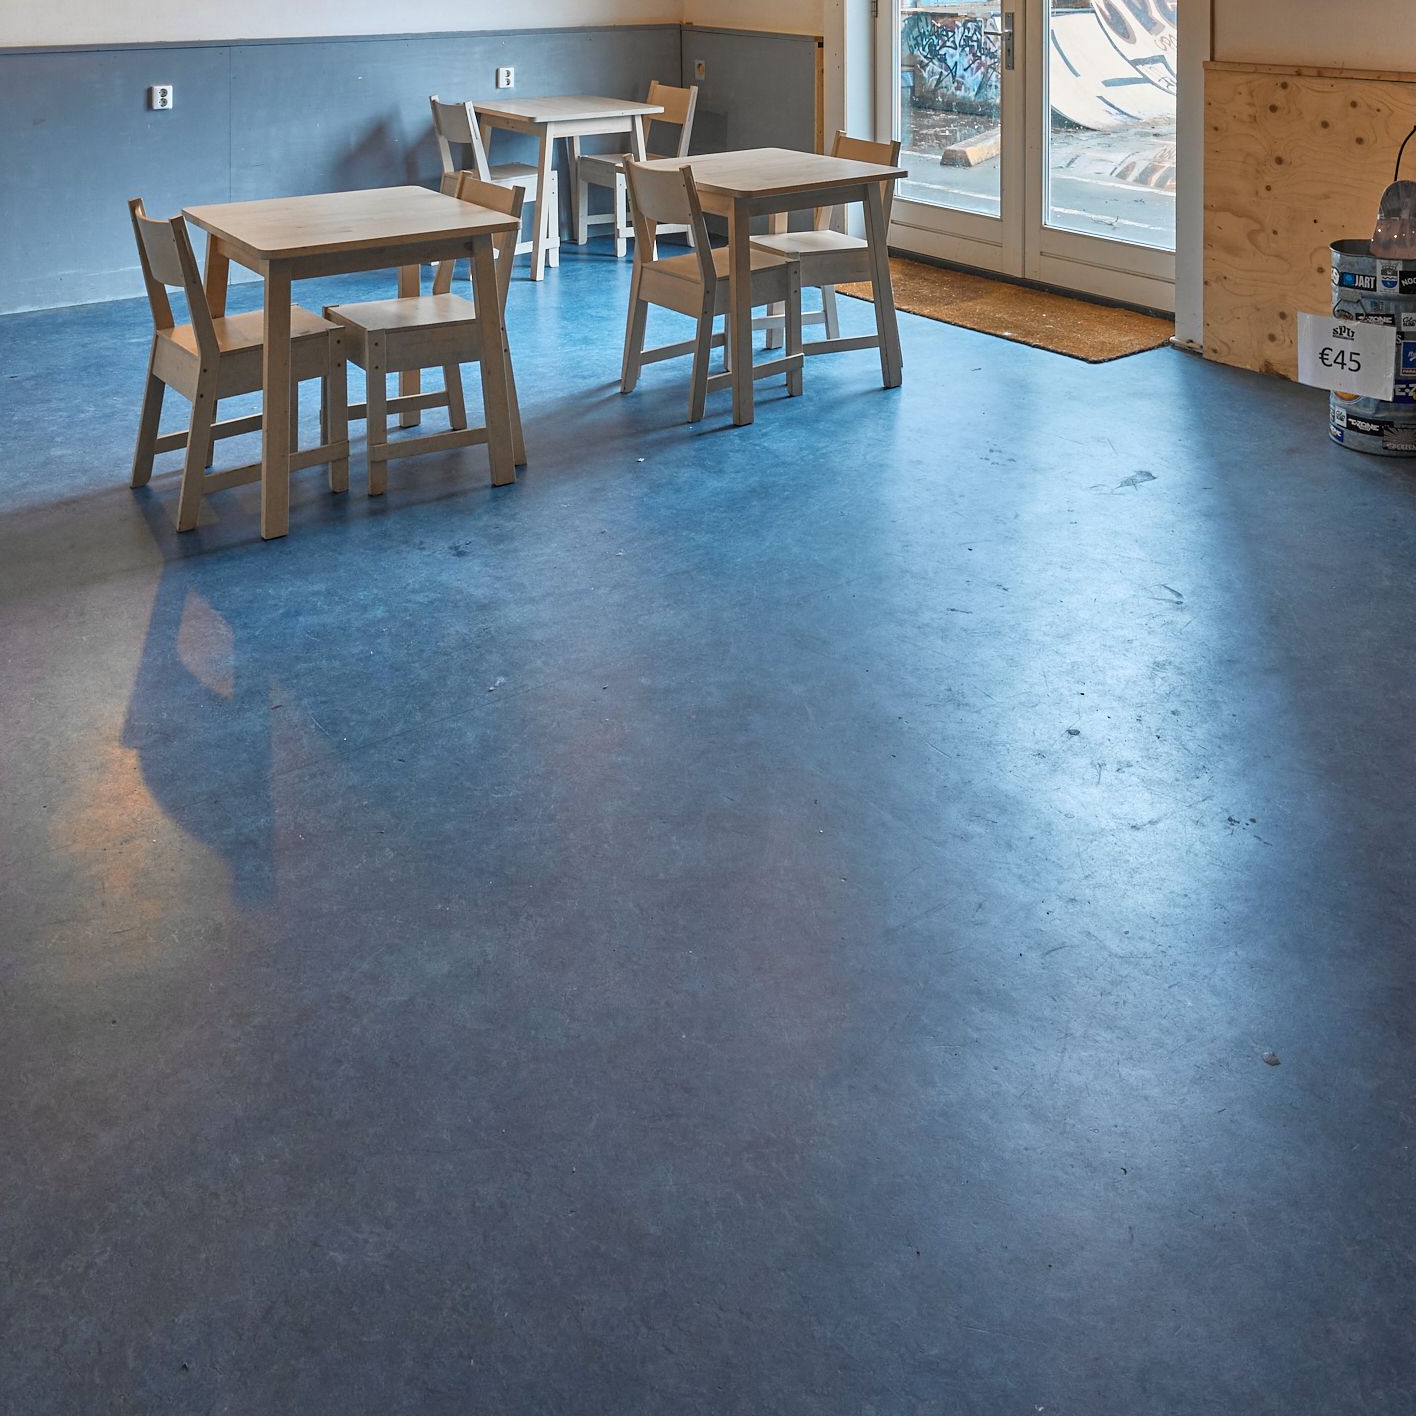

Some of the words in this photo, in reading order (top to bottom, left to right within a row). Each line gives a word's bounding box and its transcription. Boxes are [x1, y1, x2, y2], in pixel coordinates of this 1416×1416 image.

[1355, 275, 1375, 289] JART
[1332, 325, 1355, 338] SPU
[1319, 347, 1361, 372] €45
